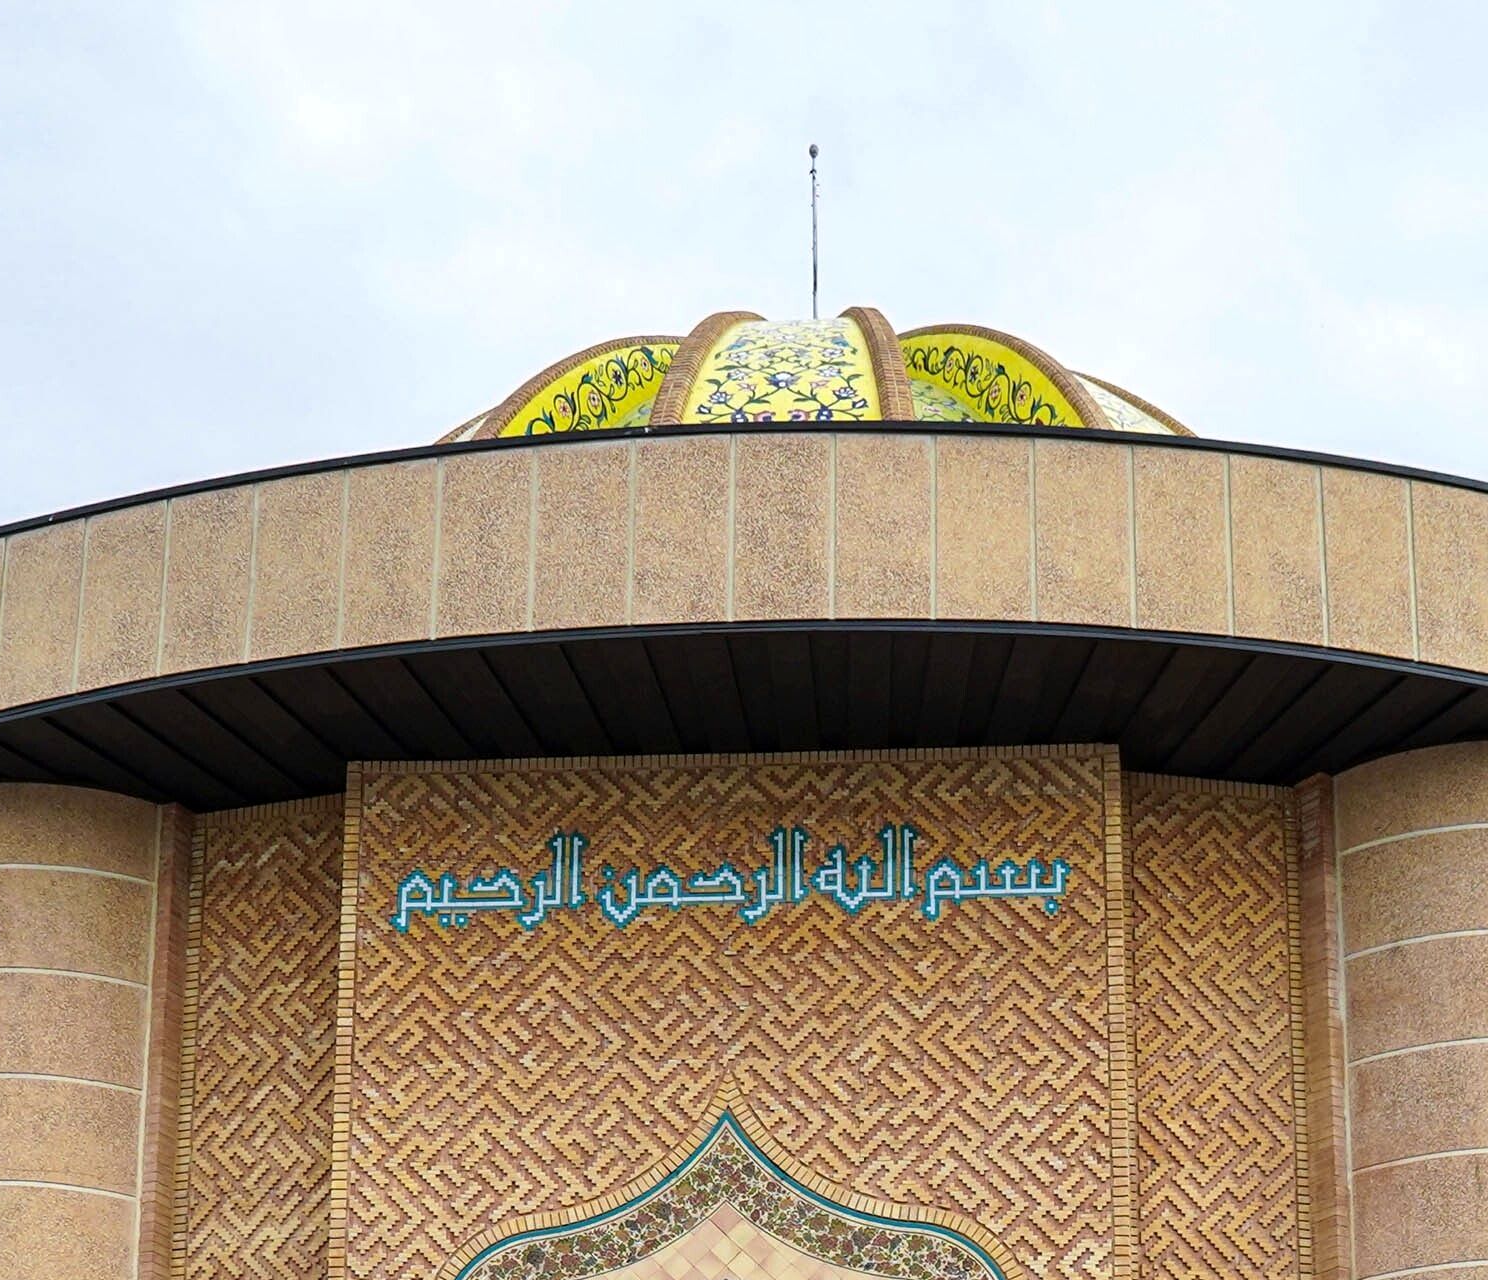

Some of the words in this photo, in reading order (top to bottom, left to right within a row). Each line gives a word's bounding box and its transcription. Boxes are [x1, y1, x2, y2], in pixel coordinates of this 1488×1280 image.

[595, 825, 811, 930] الرحمن
[809, 825, 920, 916] الله
[919, 857, 1072, 922] بسم
